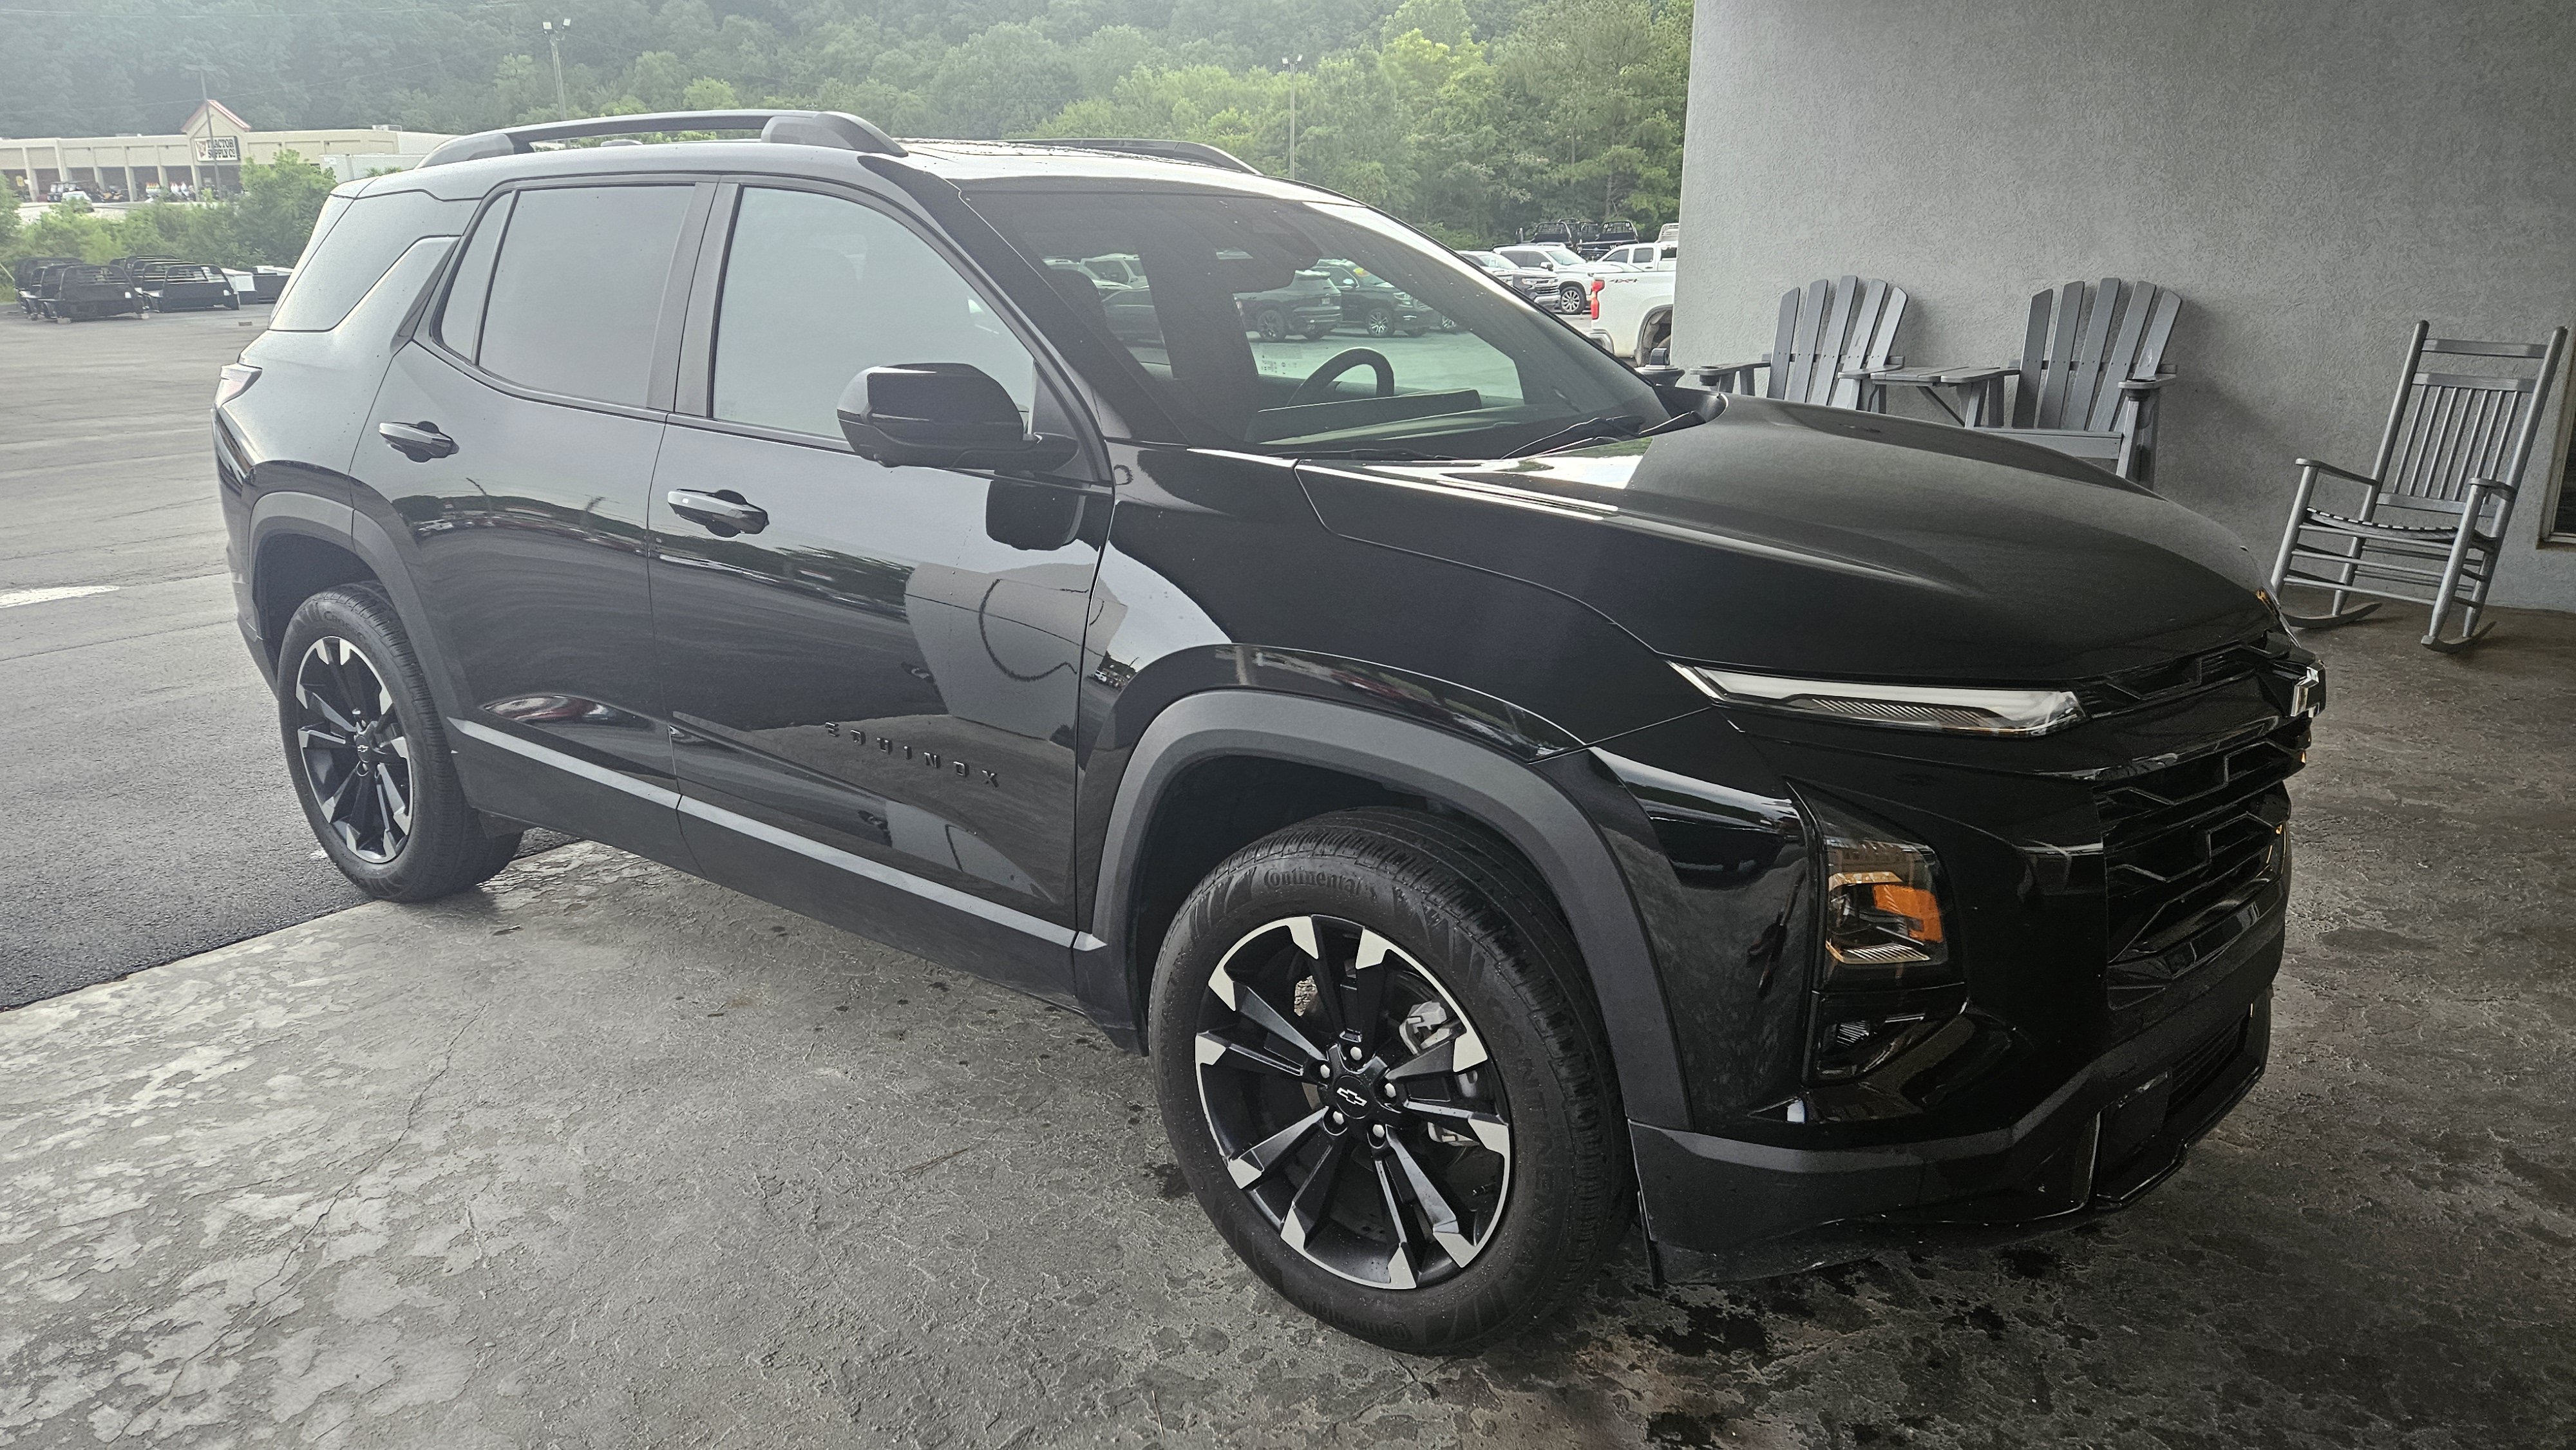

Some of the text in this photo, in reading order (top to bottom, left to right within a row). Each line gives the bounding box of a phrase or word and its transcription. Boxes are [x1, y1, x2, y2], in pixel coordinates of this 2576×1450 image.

[206, 138, 234, 148] TACTOR
[207, 149, 228, 158] SPPLY
[825, 722, 999, 788] EQUINOX
[1264, 867, 1361, 897] Continental
